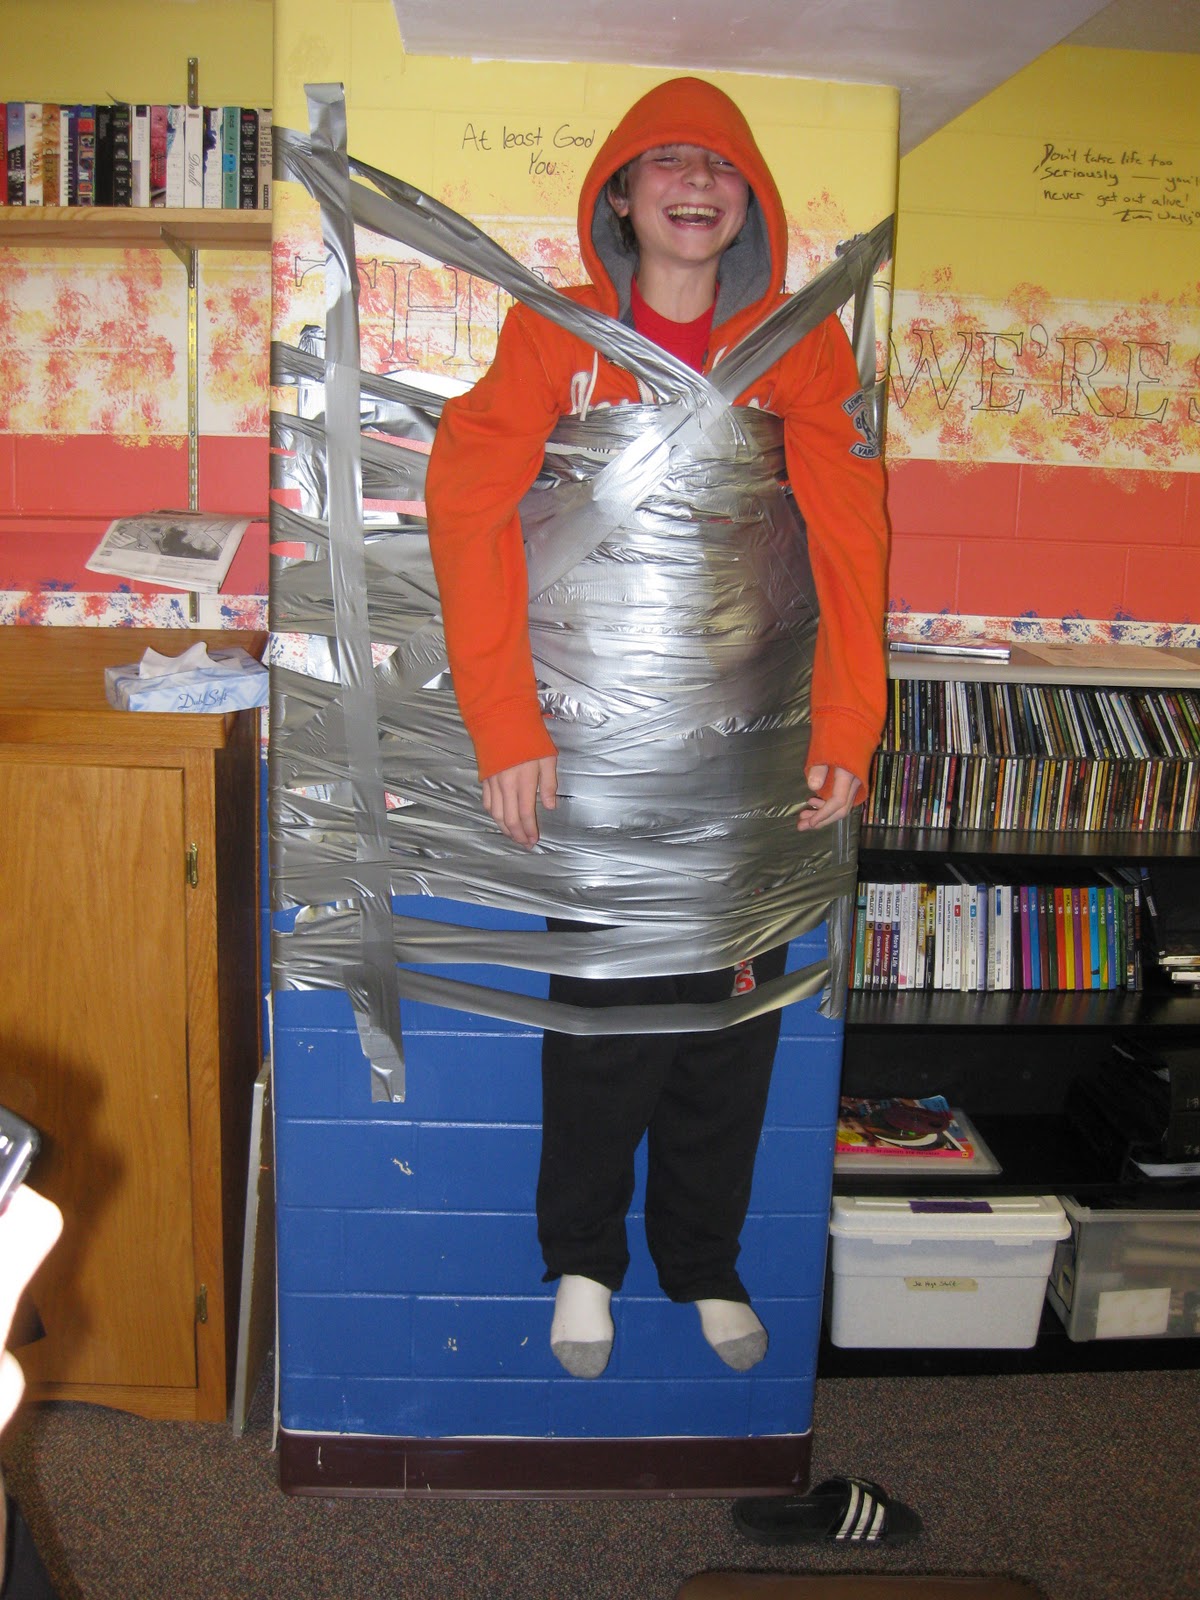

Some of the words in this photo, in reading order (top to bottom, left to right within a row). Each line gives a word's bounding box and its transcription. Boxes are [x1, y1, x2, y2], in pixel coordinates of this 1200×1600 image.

[462, 123, 491, 151] At
[503, 126, 543, 150] least
[552, 124, 595, 149] God
[1040, 144, 1076, 166] Don't
[1084, 148, 1115, 165] take
[1121, 151, 1142, 165] life
[1147, 154, 1173, 167] too
[188, 152, 202, 187] Doubt
[1043, 189, 1084, 201] never
[1096, 193, 1118, 207] get
[1123, 193, 1145, 204] out
[1152, 194, 1189, 208] alive!
